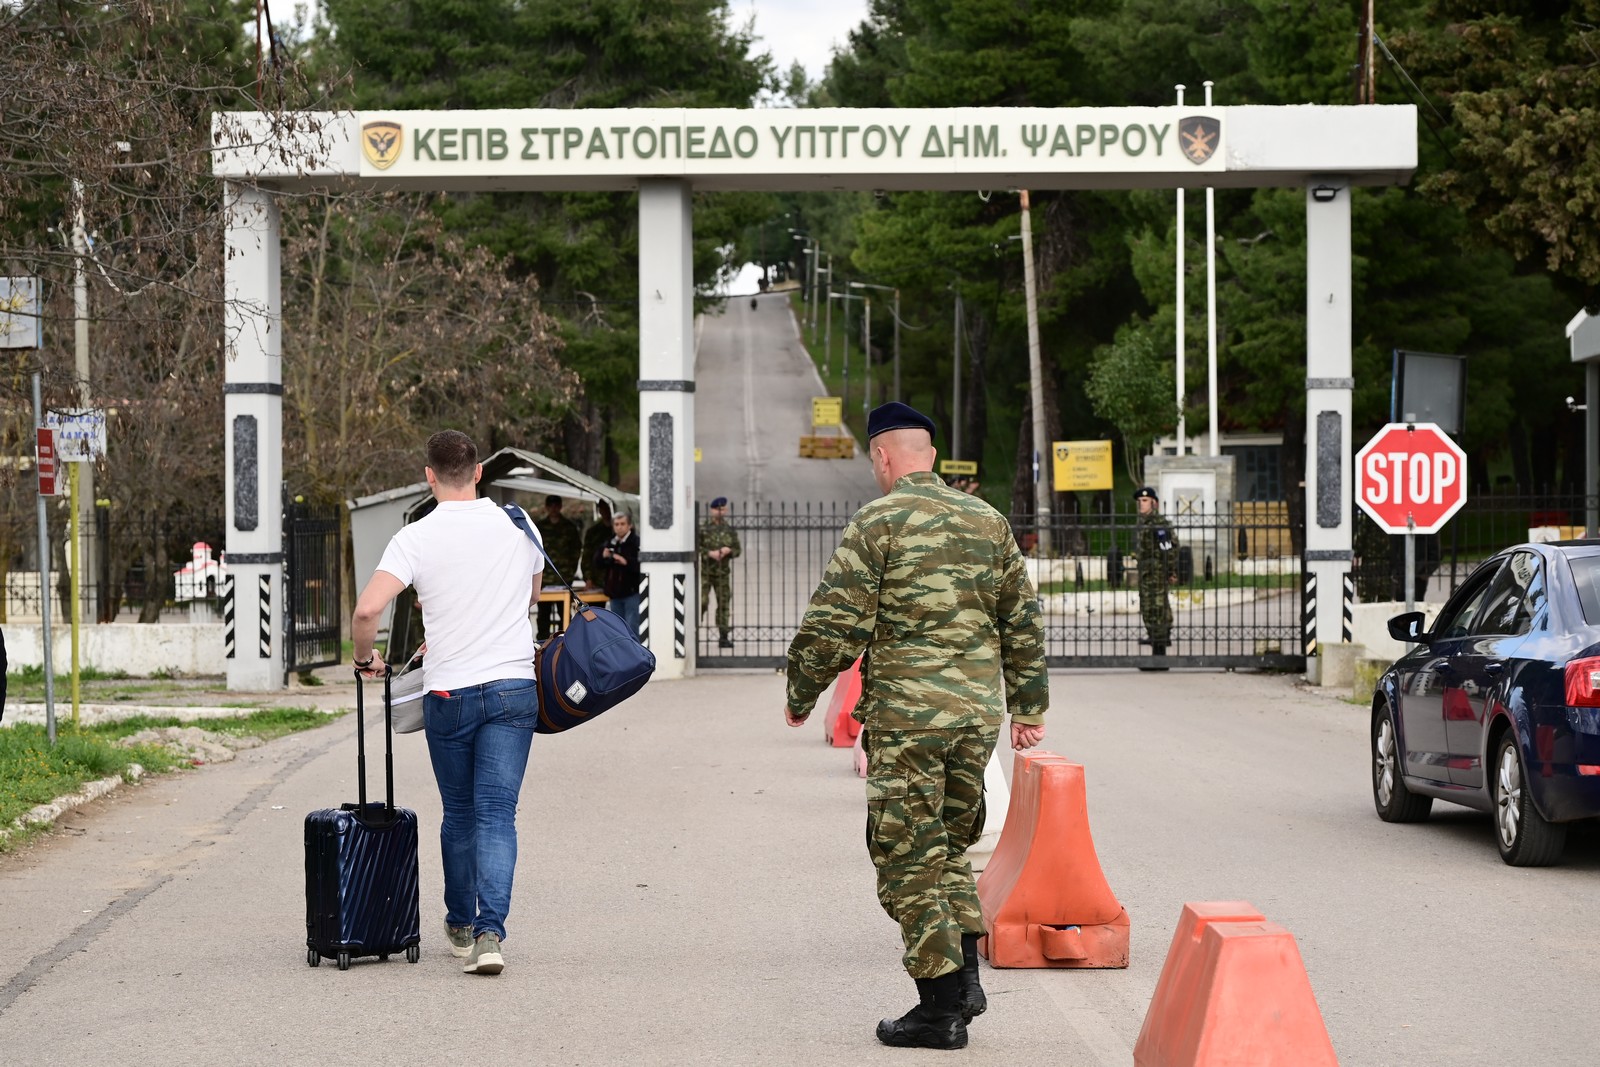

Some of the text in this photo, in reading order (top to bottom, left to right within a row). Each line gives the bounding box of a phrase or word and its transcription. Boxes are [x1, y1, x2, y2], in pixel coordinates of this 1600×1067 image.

[413, 123, 1171, 162] ΚΕΠΒ ΣΤΡΑΤΟΠΕΔΟ ΥΠΤΓΟΥ ΔΗΜ. ΨΑΡΡΟΥ
[1366, 452, 1456, 505] STOP
